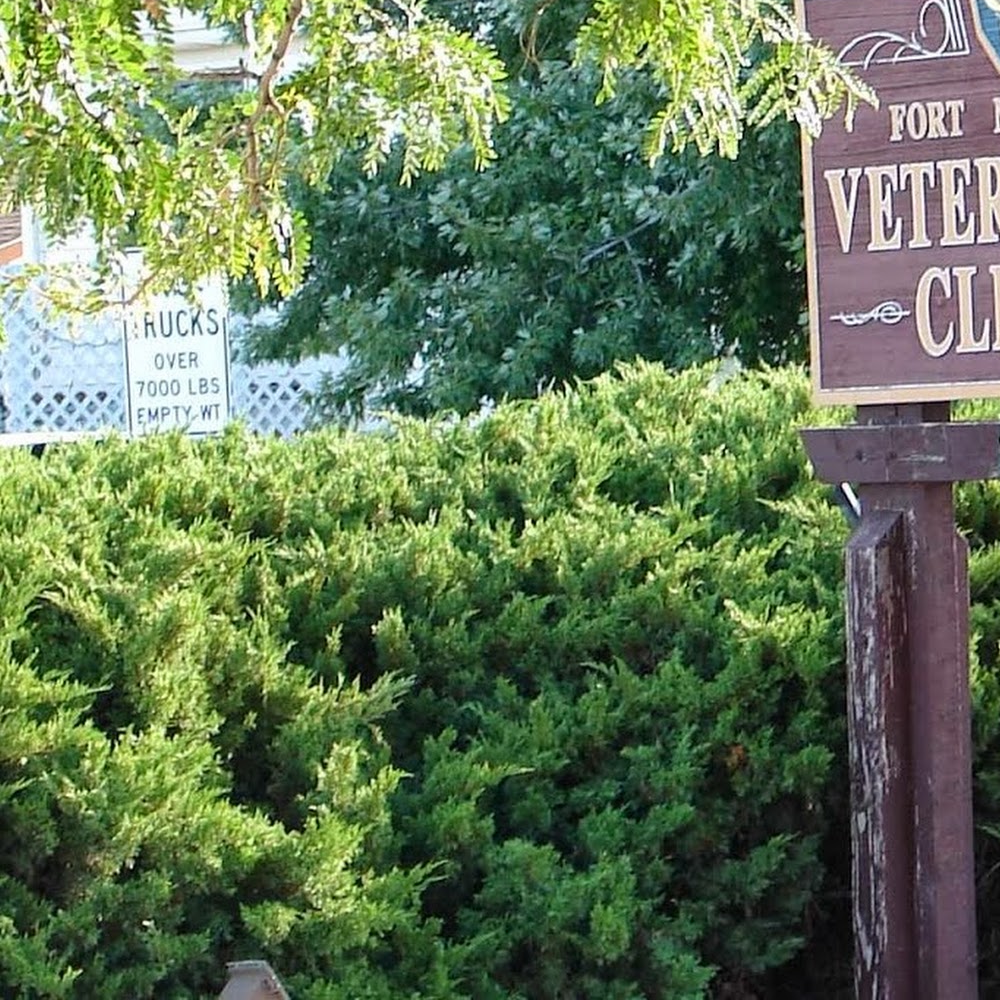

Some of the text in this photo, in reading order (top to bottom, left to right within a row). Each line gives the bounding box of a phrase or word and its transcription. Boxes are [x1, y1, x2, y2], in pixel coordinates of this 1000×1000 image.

[889, 99, 964, 142] FORT
[154, 351, 199, 371] OVER
[135, 377, 220, 397] 7000 LBS
[137, 403, 220, 425] EMPTY WT
